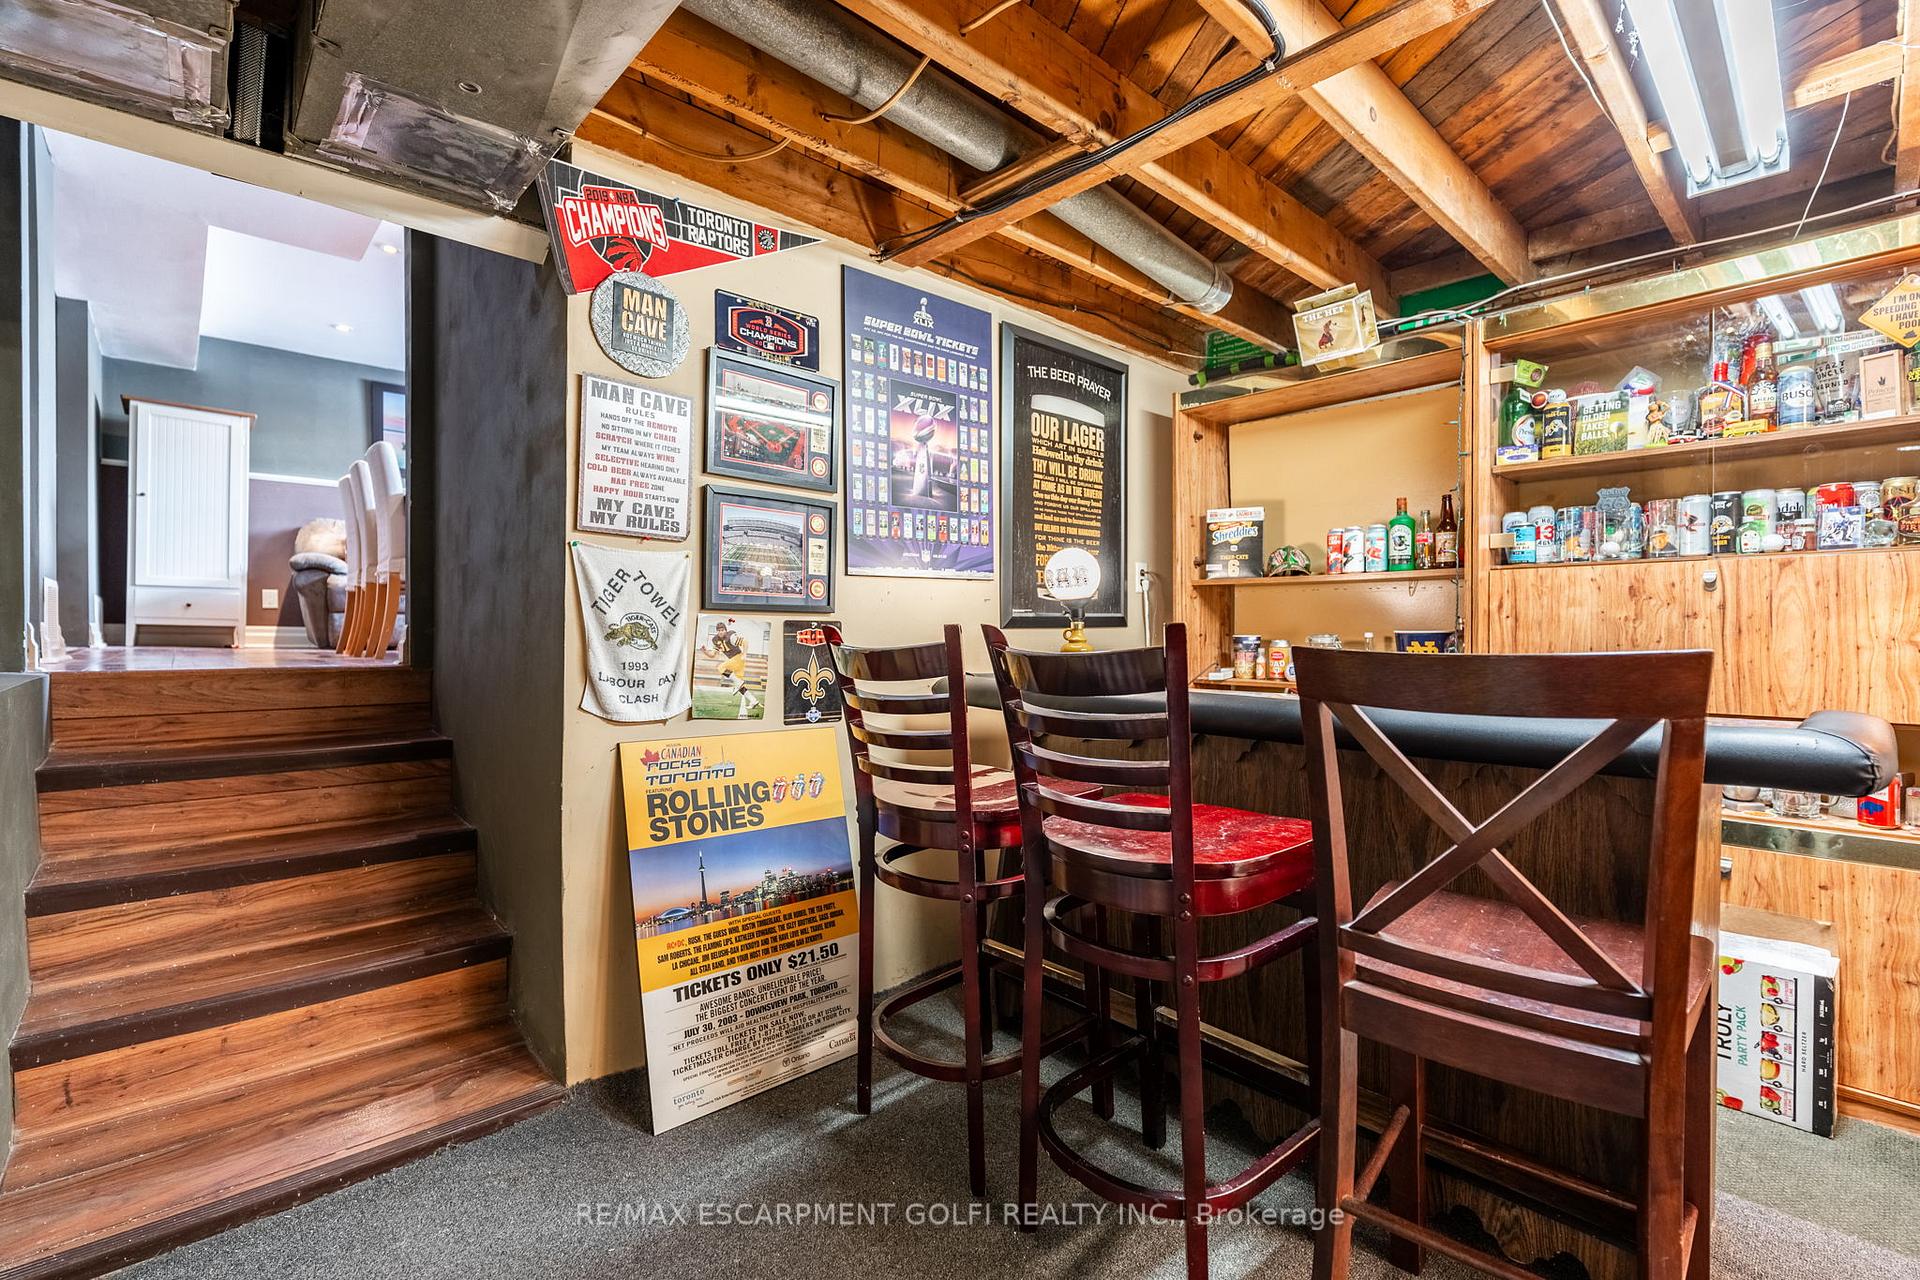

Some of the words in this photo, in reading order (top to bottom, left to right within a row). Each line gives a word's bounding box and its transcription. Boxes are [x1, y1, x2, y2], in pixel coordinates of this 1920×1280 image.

[585, 188, 609, 201] 2019
[616, 192, 635, 204] NBA
[565, 200, 667, 248] CHAMPIONS
[687, 206, 750, 239] TORONTO
[687, 226, 750, 257] RAPTORS
[623, 288, 667, 320] MAN
[1873, 302, 1917, 316] SPEEDING
[1893, 295, 1907, 304] I'M
[622, 310, 667, 341] CAVE
[913, 317, 935, 329] XLIX
[1303, 311, 1323, 323] THE
[1896, 311, 1919, 321] HAVE
[740, 327, 798, 349] CHAMPIONS
[746, 323, 768, 333] WORLD
[769, 330, 791, 340] SERIES
[864, 315, 902, 334] SUPER
[904, 326, 935, 344] BOWL
[935, 336, 979, 355] TICKETS
[1027, 365, 1048, 379] THE
[1050, 367, 1076, 385] BEER
[1077, 376, 1111, 401] PRAYER
[591, 379, 633, 404] MAN
[640, 391, 687, 416] CAVE
[893, 394, 955, 421] XLIX
[910, 391, 928, 400] SUPER
[929, 393, 943, 403] BOWL
[1583, 400, 1621, 415] GETTING
[600, 411, 620, 421] HANDS
[634, 418, 644, 426] THE
[646, 420, 677, 433] REMOTE
[625, 406, 655, 419] RULES
[1583, 411, 1610, 423] OLDER
[601, 422, 609, 430] NO
[611, 424, 634, 434] SITTING
[643, 430, 652, 438] MY
[653, 432, 676, 442] CHAIR
[1031, 412, 1059, 441] OUR
[1063, 420, 1105, 451] LAGER
[1583, 421, 1608, 432] TAKES
[595, 431, 632, 444] SCRATCH
[634, 439, 654, 449] WHERE
[661, 444, 680, 453] ITCHES
[1032, 437, 1053, 447] WHICH
[1055, 442, 1066, 450] ART
[1077, 447, 1104, 458] BARRELS
[594, 453, 639, 467] SELECTIVE
[640, 461, 664, 471] HEARING
[665, 465, 679, 474] ONLY
[601, 443, 611, 451] MY
[612, 445, 629, 454] TEAM
[630, 449, 654, 459] ALWAYS
[656, 453, 675, 463] WINS
[1032, 445, 1063, 460] Hallowed
[1064, 452, 1073, 462] be
[1073, 453, 1085, 465] thy
[1085, 456, 1104, 468] drink
[586, 462, 607, 472] COLD
[610, 466, 631, 476] BEER
[632, 470, 656, 480] ALWAYS
[657, 474, 685, 484] AVAILABLE
[1032, 458, 1048, 473] THY
[1049, 460, 1066, 477] WILL
[1068, 463, 1078, 478] BE
[1079, 465, 1104, 483] DRUNK
[593, 485, 619, 495] HAPPY
[623, 489, 643, 498] HOUR
[644, 493, 665, 501] STARTS
[610, 477, 626, 486] NAG
[629, 480, 649, 489] FREE
[650, 483, 664, 491] ZONE
[596, 497, 624, 512] MY
[632, 502, 675, 519] CAVE
[1775, 502, 1805, 514] odelo
[589, 510, 617, 525] MY
[625, 515, 680, 533] RULES
[1213, 526, 1257, 542] Shreddies
[1535, 525, 1554, 540] 13
[1227, 560, 1240, 576] 6
[591, 568, 631, 615] TIGER
[633, 570, 680, 627] TOWEL
[625, 615, 656, 634] TIGER-CATS
[621, 661, 649, 671] 1993
[659, 672, 677, 686] DAY
[619, 694, 658, 704] CLASH
[660, 745, 702, 759] CANADIAN
[646, 780, 770, 818] ROLLING
[648, 803, 764, 843] STONES
[672, 969, 741, 1003] TICKETS
[746, 958, 782, 982] ONLY
[787, 941, 838, 970] $21.50
[699, 994, 731, 1012] AWESOME
[757, 973, 800, 993] UNBELIEVABLE
[802, 967, 821, 979] PRICE!
[683, 1025, 699, 1039] JULY
[702, 1020, 715, 1033] 30,
[717, 1013, 737, 1028] 2003
[745, 997, 787, 1018] DOWNSVIEW
[789, 990, 808, 1004] PARK,
[810, 981, 838, 996] TORONTO
[695, 1011, 708, 1023] THE
[710, 1002, 737, 1018] BIGGEST
[739, 992, 767, 1008] CONCERT
[769, 986, 787, 998] EVENT
[789, 983, 796, 992] OF
[798, 979, 808, 989] THE
[1737, 1005, 1748, 1028] PACK
[727, 1026, 756, 1043] TICKETS
[758, 1023, 768, 1032] ON
[770, 1016, 786, 1028] SALE
[672, 1052, 723, 1076] TICKETMASTER
[724, 1042, 750, 1058] CHARGE
[752, 1039, 760, 1047] BY
[762, 1030, 784, 1043] PHONE
[785, 1020, 813, 1035] NUMBERS
[815, 1017, 820, 1025] IN
[822, 1011, 837, 1022] YOUR
[828, 1031, 855, 1050] Canada
[1736, 1029, 1747, 1066] PARTY
[673, 1087, 704, 1105] toronto
